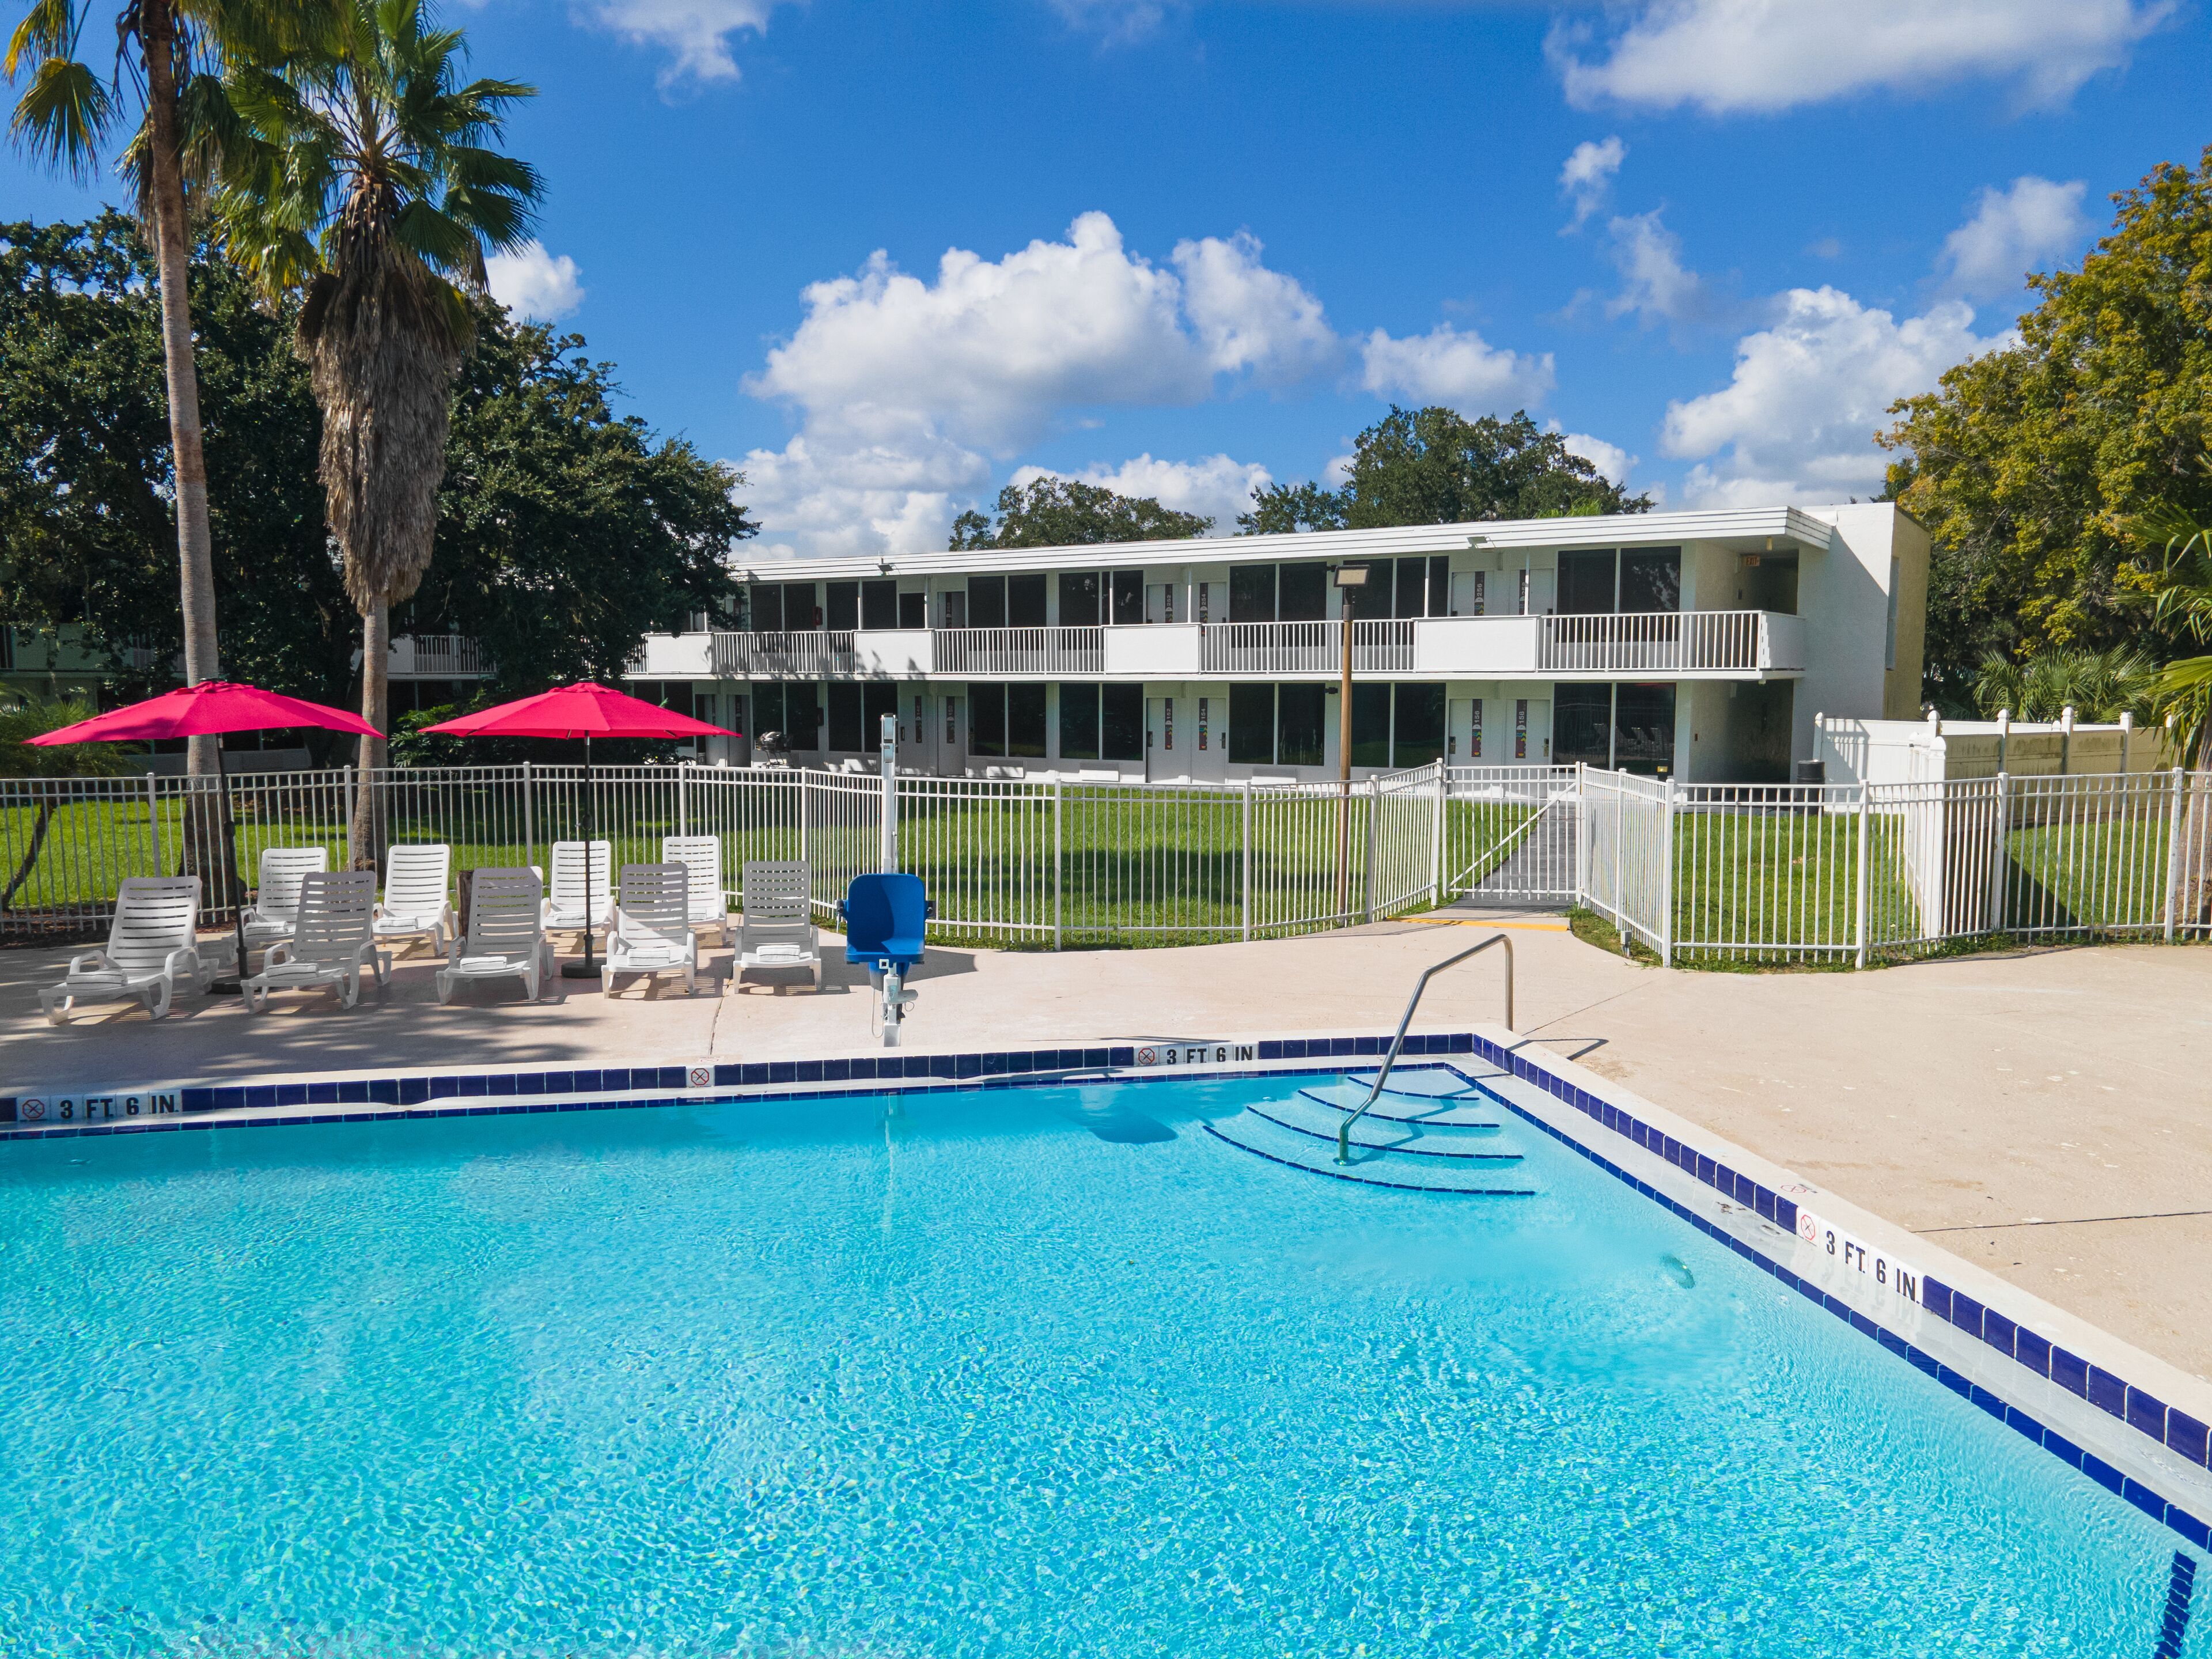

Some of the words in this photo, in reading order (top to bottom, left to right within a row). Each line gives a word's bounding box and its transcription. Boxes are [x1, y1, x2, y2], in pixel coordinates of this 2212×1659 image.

[1166, 1049, 1176, 1065] 3
[1216, 1047, 1226, 1062] 6
[60, 1100, 73, 1119] 3
[86, 1098, 114, 1118] FT.
[126, 1097, 139, 1115] 6
[151, 1094, 179, 1114] IN.
[1826, 1230, 1835, 1255] 3
[1845, 1241, 1865, 1274] FT.
[1876, 1258, 1886, 1284] 6
[1896, 1268, 1921, 1304] IN.
